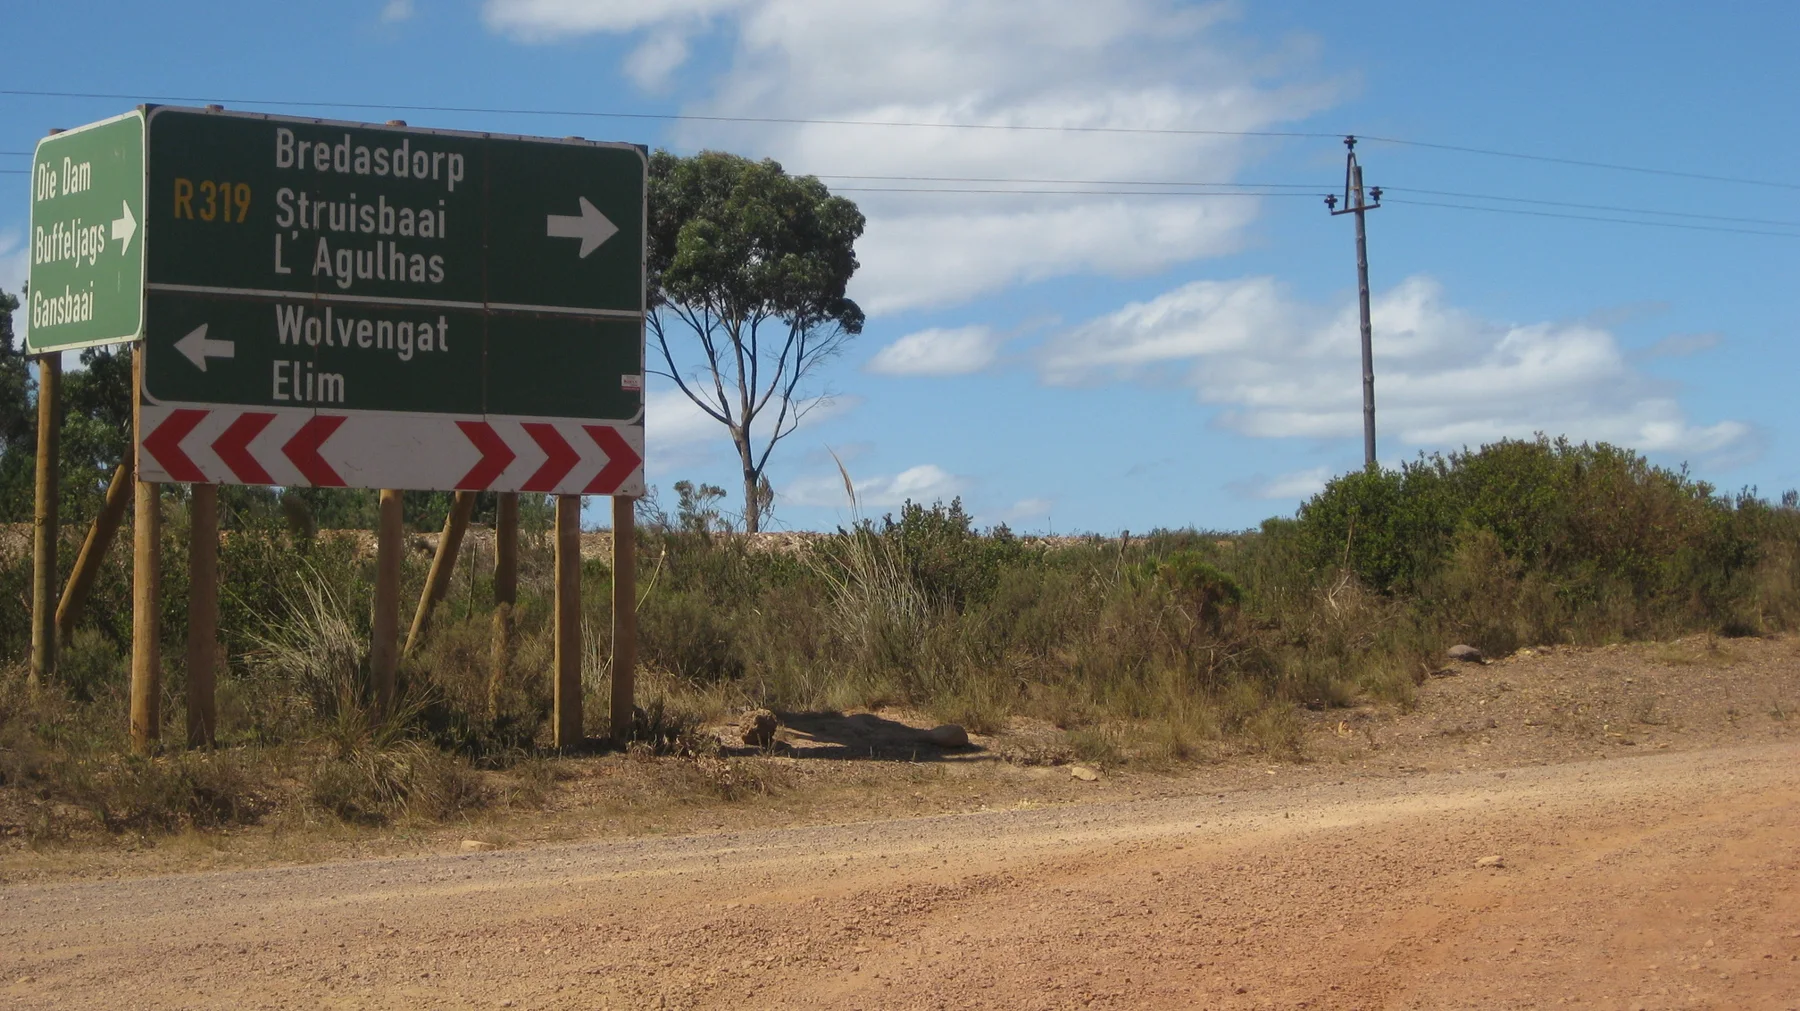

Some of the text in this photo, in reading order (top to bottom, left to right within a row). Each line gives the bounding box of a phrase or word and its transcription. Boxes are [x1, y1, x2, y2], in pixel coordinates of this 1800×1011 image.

[37, 156, 91, 202] Die Dam
[276, 127, 464, 192] Bredasdorp
[275, 187, 445, 239] Struisbaai
[35, 218, 105, 269] Buffeljags
[311, 236, 445, 289] Agulhas
[33, 280, 94, 329] Gansbaai
[275, 303, 449, 362] Wolvengat
[272, 359, 345, 403] Elim
